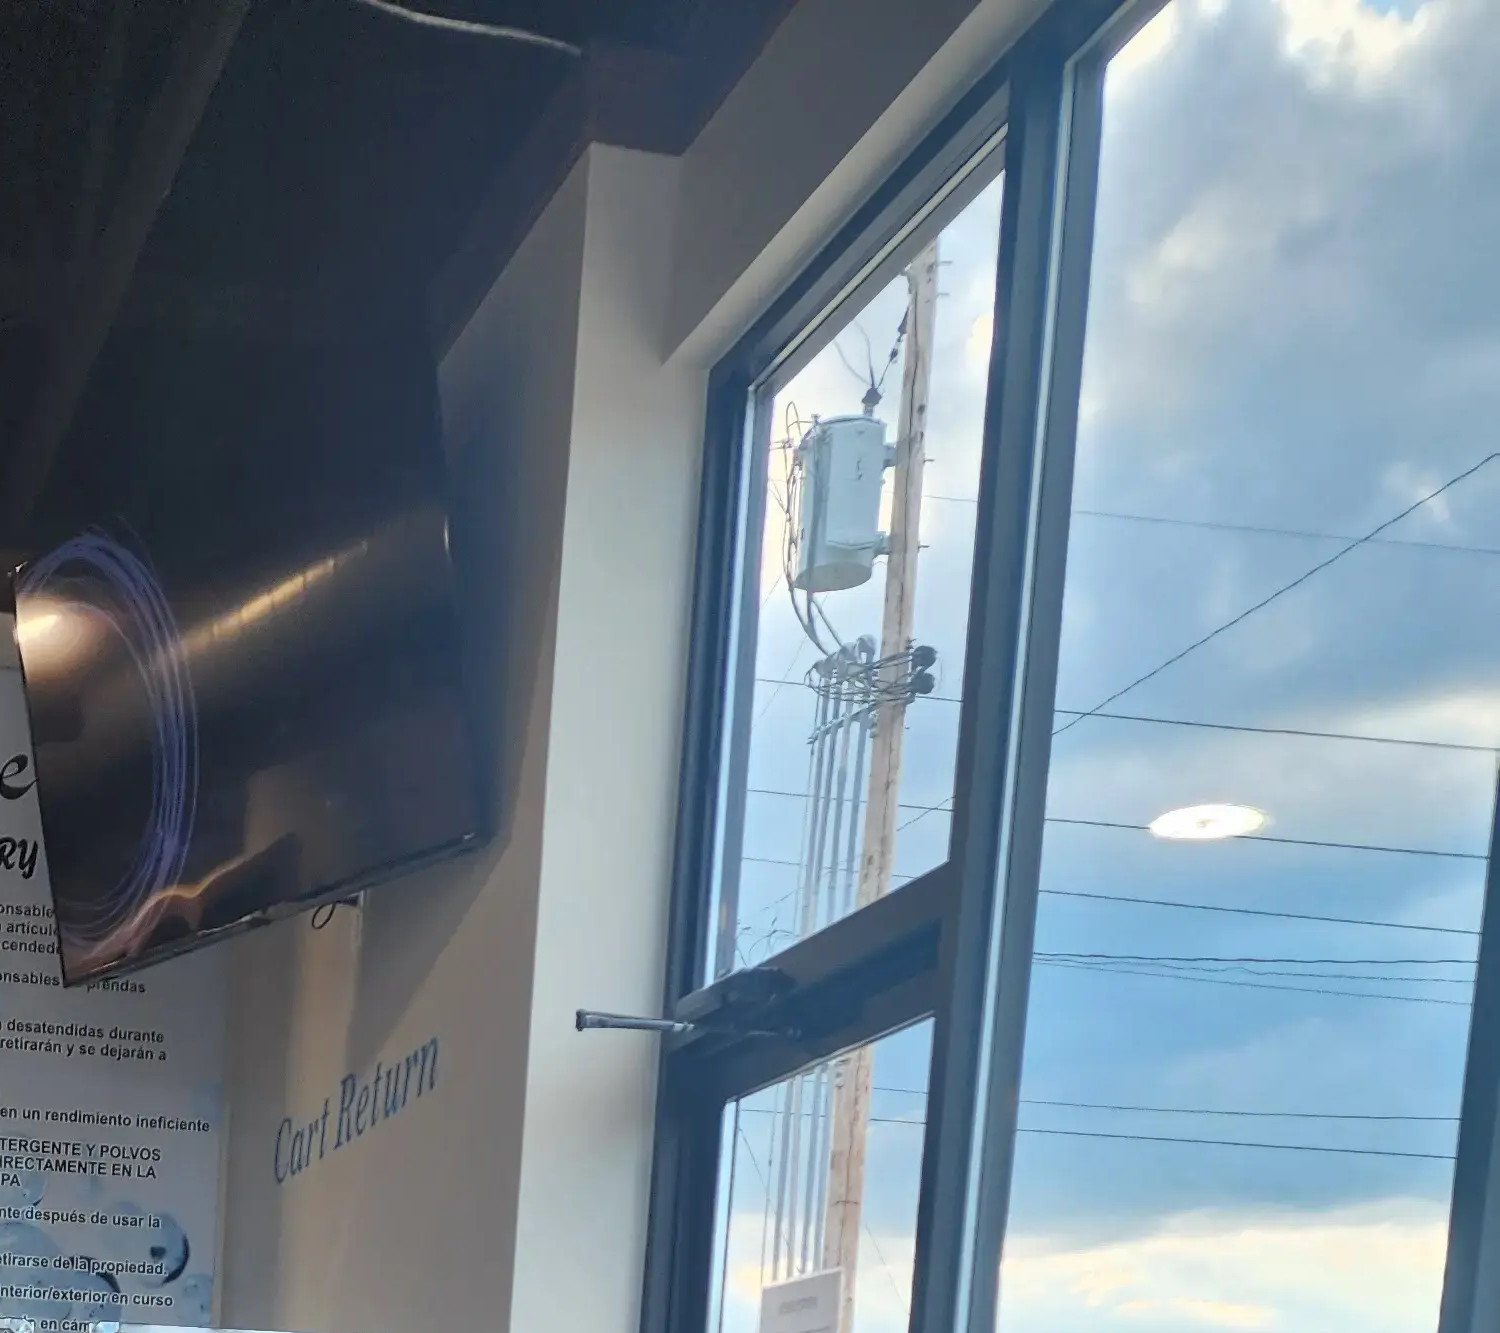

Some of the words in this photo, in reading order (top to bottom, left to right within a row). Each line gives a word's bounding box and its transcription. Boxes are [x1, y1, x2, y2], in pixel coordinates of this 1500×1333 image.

[6, 1017, 104, 1038] desatendidas
[108, 1025, 163, 1043] durante
[0, 1036, 61, 1053] retirarán
[66, 1043, 74, 1056] y
[79, 1044, 95, 1055] se
[100, 1043, 153, 1060] dejarán
[158, 1050, 166, 1061] a
[0, 1106, 17, 1118] en
[22, 1108, 40, 1119] un
[44, 1108, 131, 1126] rendimiento
[135, 1113, 209, 1131] ineficiente
[274, 1098, 329, 1184] Cart
[334, 1036, 438, 1150] Return
[86, 1143, 94, 1156] Y
[99, 1144, 160, 1160] POLVOS
[111, 1162, 132, 1176] EN
[136, 1164, 156, 1178] LA
[25, 1206, 86, 1224] después
[90, 1210, 107, 1224] de
[112, 1215, 144, 1227] usar
[148, 1214, 160, 1228] la
[53, 1255, 70, 1269] de
[75, 1256, 87, 1270] la
[91, 1259, 167, 1275] propiedad.
[111, 1292, 128, 1303] en
[133, 1294, 173, 1306] curso
